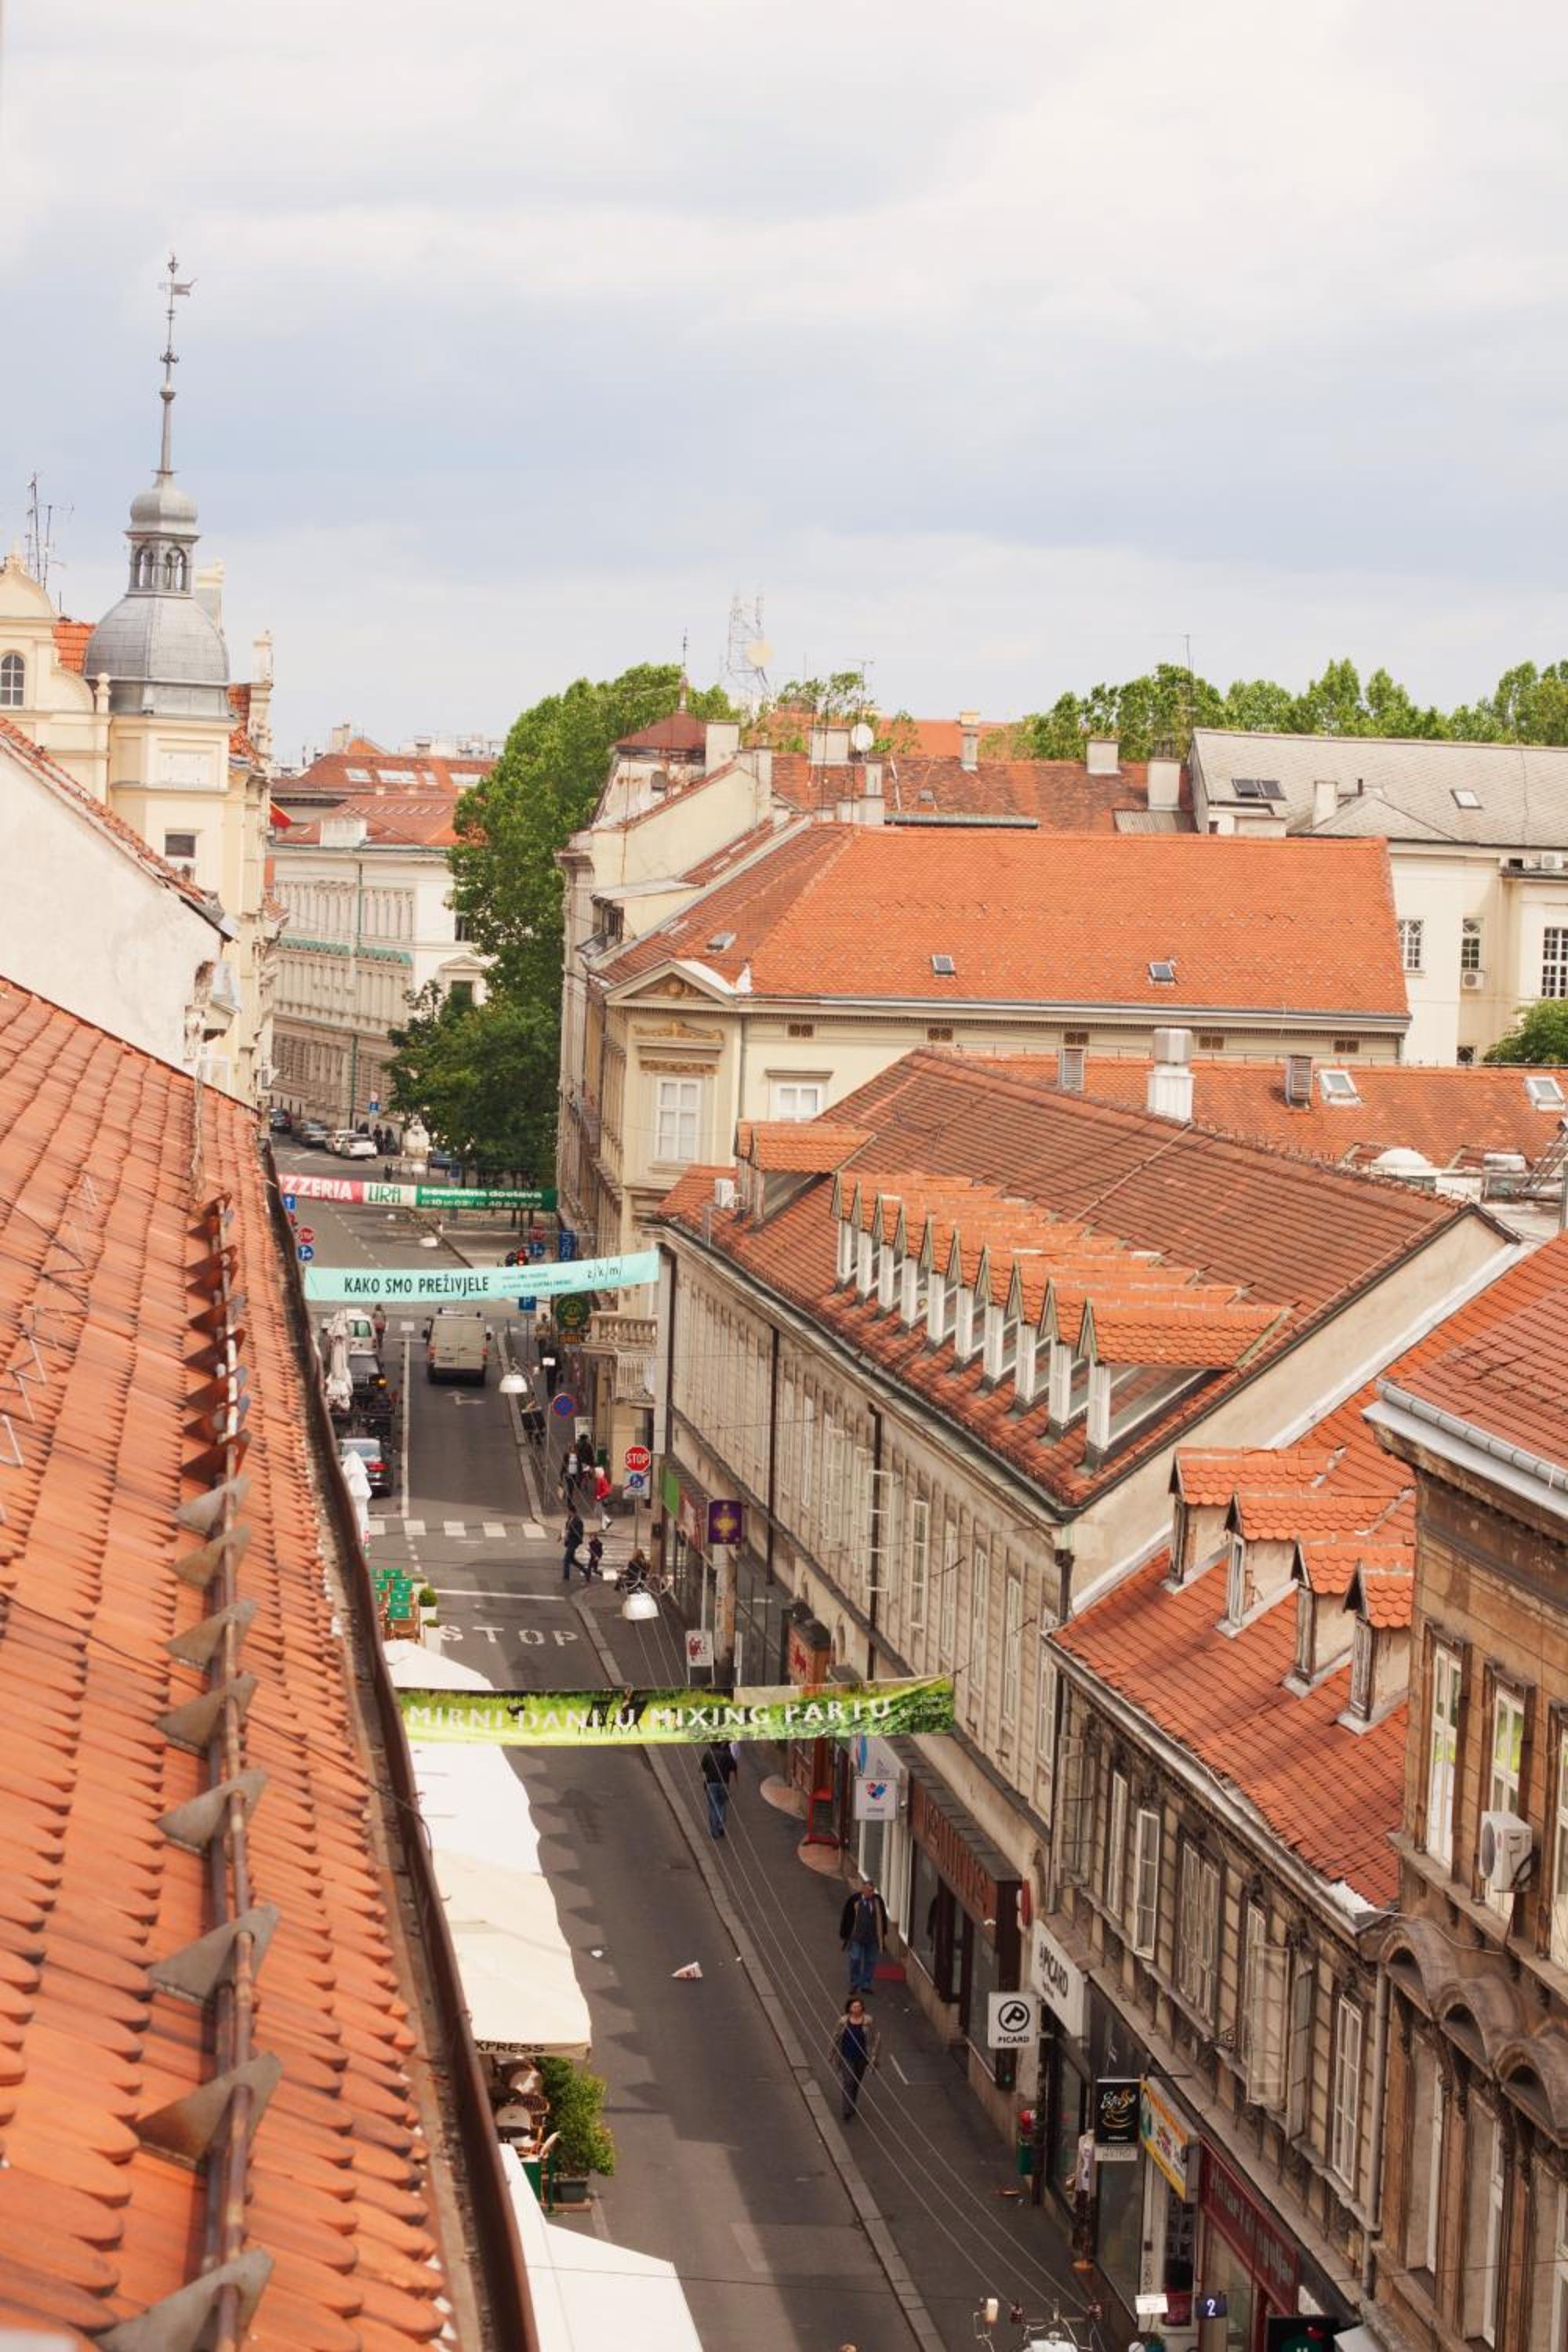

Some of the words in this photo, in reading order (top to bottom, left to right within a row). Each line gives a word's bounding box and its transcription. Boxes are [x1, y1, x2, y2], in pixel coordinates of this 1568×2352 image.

[344, 1277, 380, 1293] KAKO
[385, 1278, 412, 1294] SMO
[419, 1274, 489, 1296] PREŽIVJELE
[626, 1453, 649, 1464] STOP
[439, 1625, 579, 1646] STOP
[408, 1705, 503, 1730] MIRNI
[650, 1706, 769, 1729] MIXING
[1207, 2299, 1216, 2316] 2
